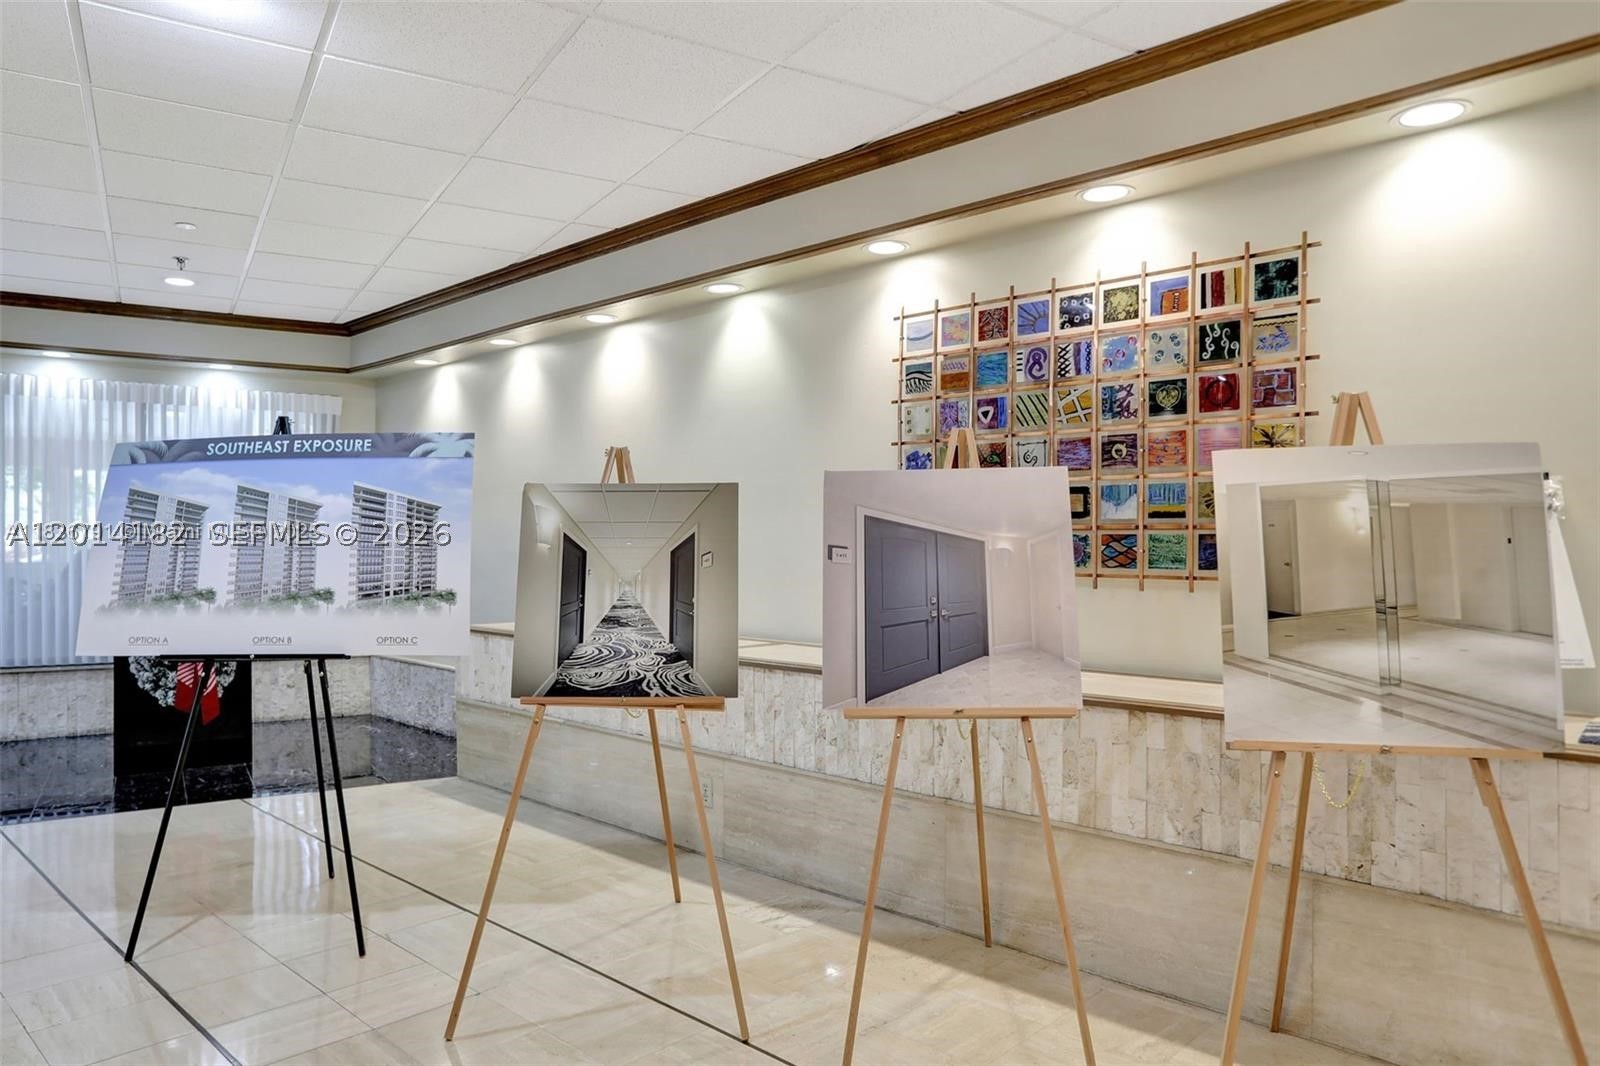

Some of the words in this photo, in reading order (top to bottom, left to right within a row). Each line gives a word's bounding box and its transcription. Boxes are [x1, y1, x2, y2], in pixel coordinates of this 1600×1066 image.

[206, 441, 290, 456] SOUTHEAST
[293, 439, 373, 453] EXPOSURE
[128, 636, 159, 645] OPTION
[161, 636, 168, 645] A
[252, 636, 284, 645] OPTION
[287, 636, 293, 645] B
[376, 636, 408, 645] OPTION
[410, 636, 418, 645] C
